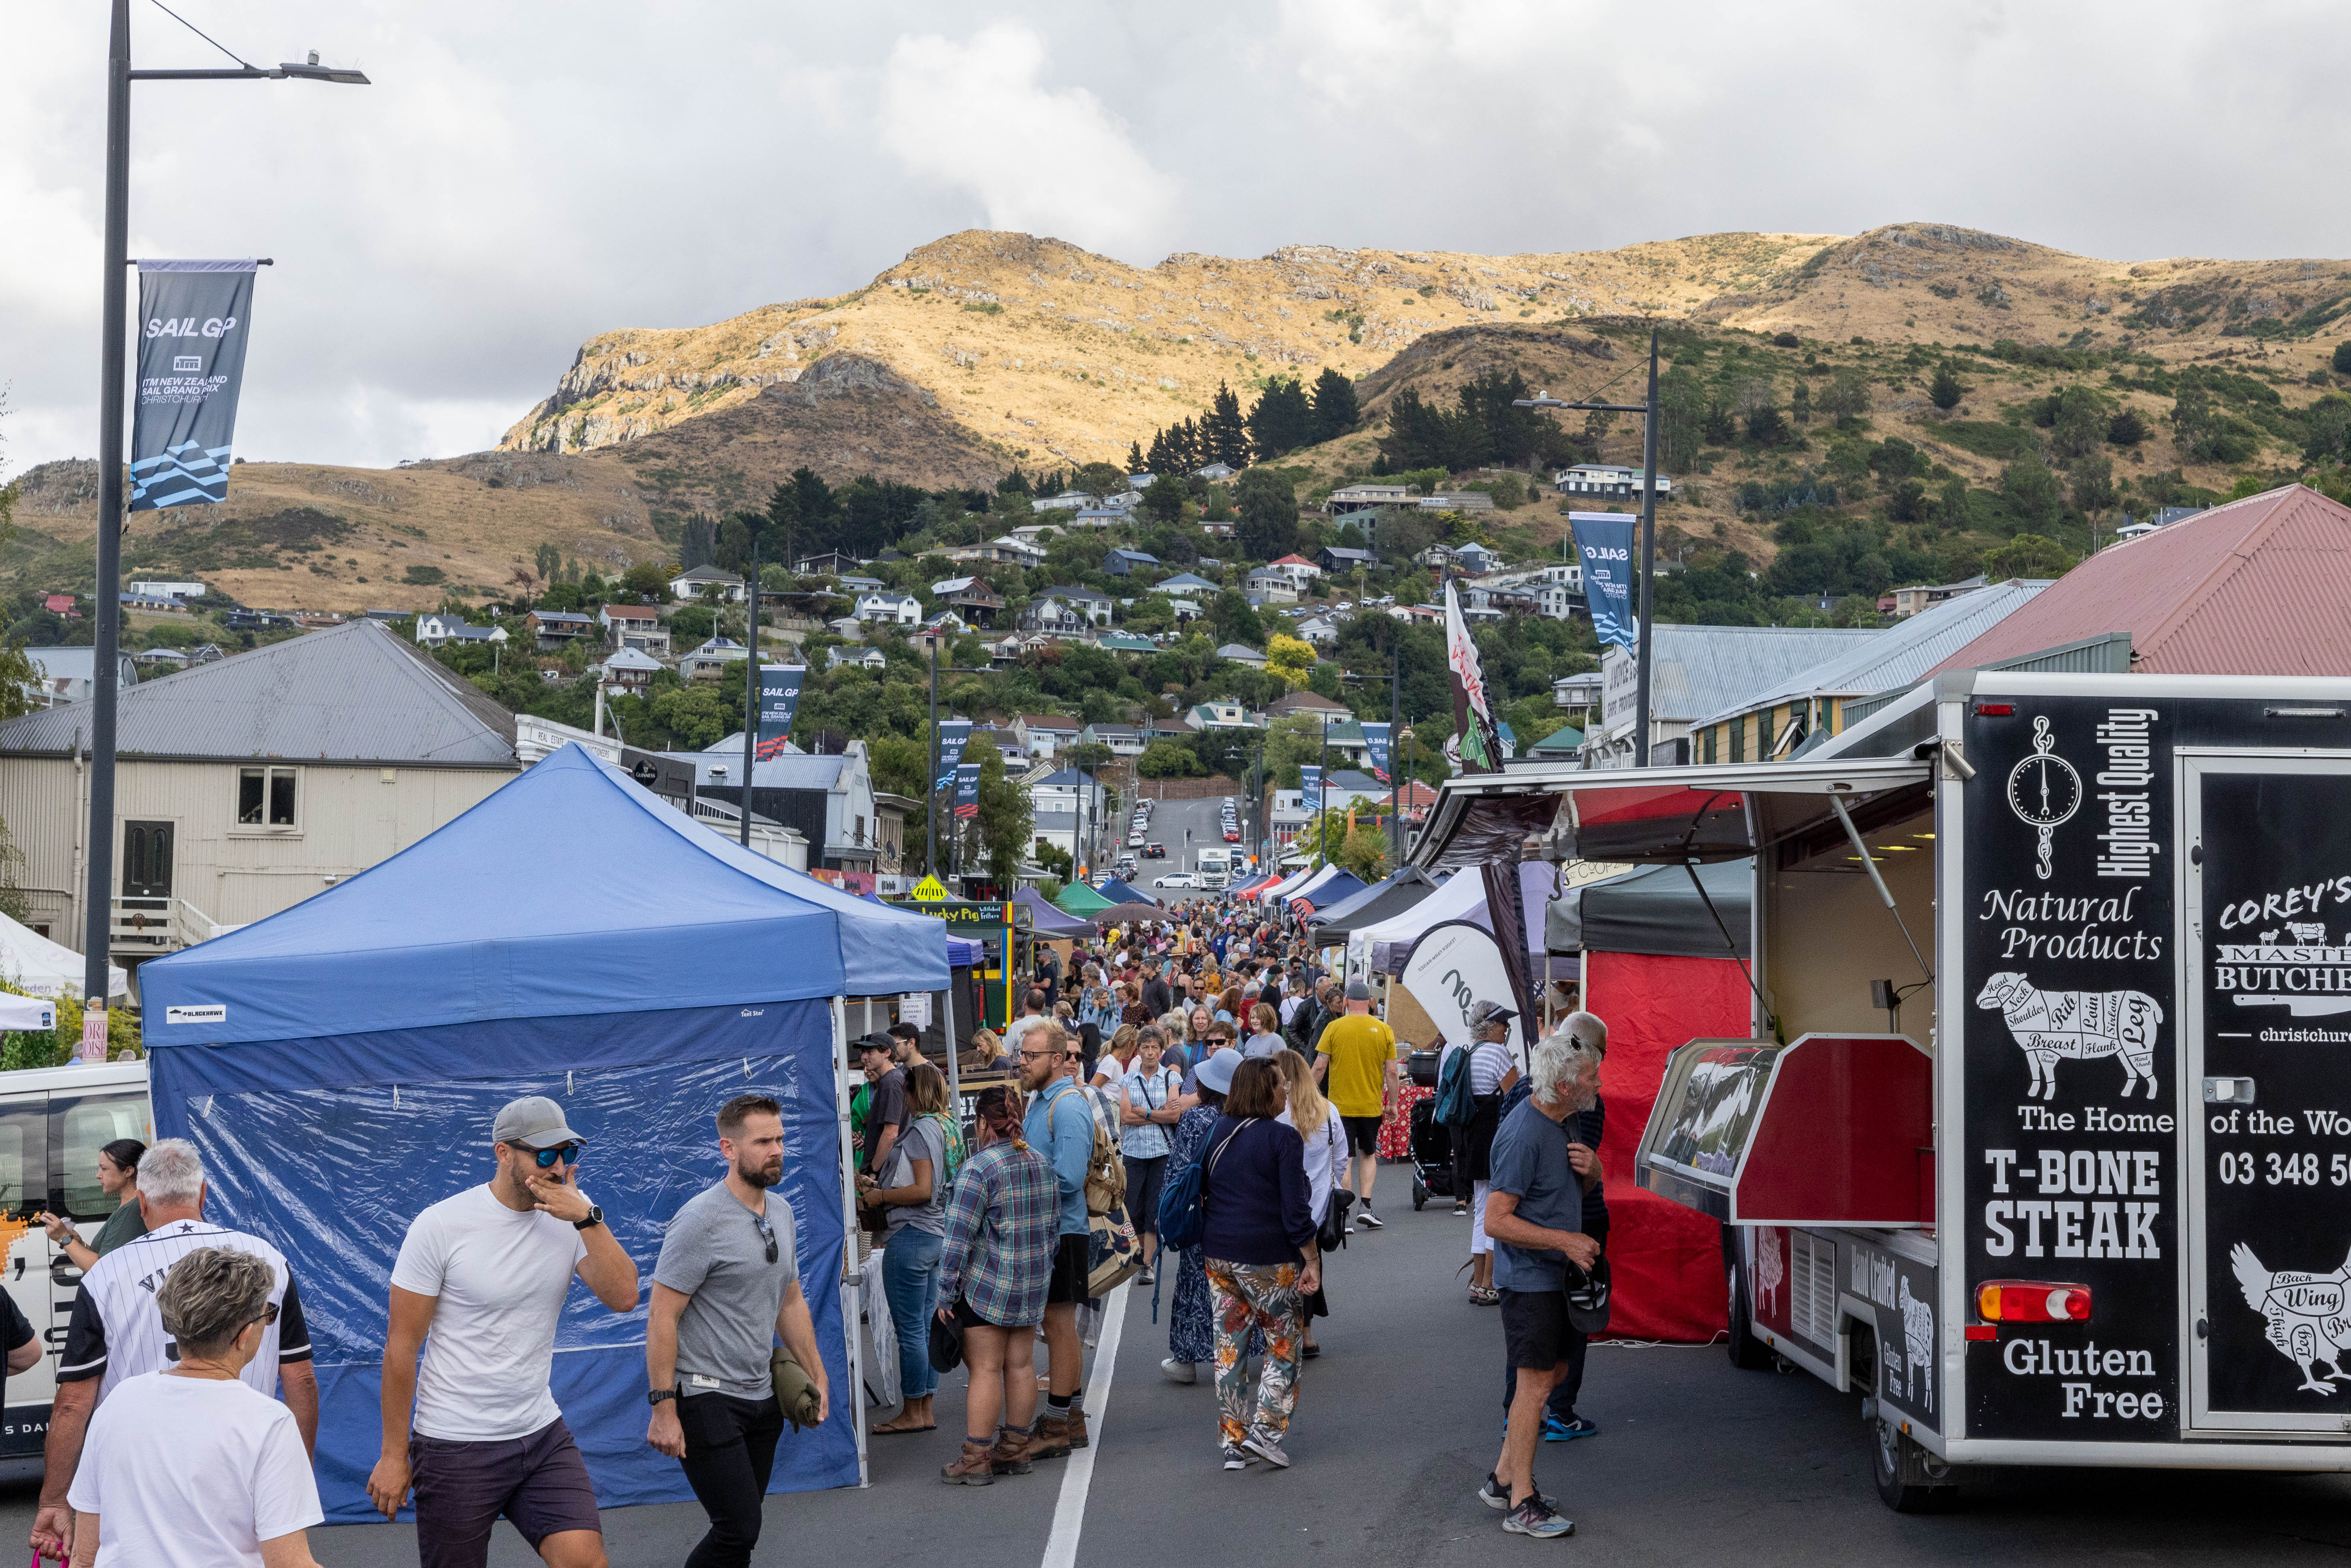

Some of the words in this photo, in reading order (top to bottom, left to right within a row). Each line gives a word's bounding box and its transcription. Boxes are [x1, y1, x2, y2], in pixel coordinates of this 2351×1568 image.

[142, 386, 162, 396] SAIL
[163, 386, 200, 395] GRAND
[143, 377, 158, 387] ITM
[159, 377, 183, 387] NEW
[141, 393, 208, 405] CHRISTCHURCH
[538, 732, 547, 742] REAL
[551, 735, 564, 747] ESTATE
[2097, 709, 2158, 785] Quality
[2097, 792, 2159, 877] Highest
[922, 907, 959, 922] Lucky
[961, 908, 979, 922] Pig
[1980, 887, 2142, 922] Natural
[2220, 876, 2351, 930] COREY'S
[2001, 923, 2162, 960] Products
[2231, 948, 2351, 962] MASTE
[1986, 974, 2008, 995] Head
[2215, 967, 2351, 991] BUTCHE
[741, 1009, 752, 1017] Tent
[1981, 999, 1998, 1008] Tongue
[2009, 986, 2030, 1012] Neck
[2051, 994, 2077, 1030] Rib
[2083, 996, 2098, 1031] Loin
[2008, 1005, 2045, 1027] Shoulder
[2106, 994, 2117, 1035] Sirloin
[2122, 995, 2151, 1049] Leg
[2027, 1033, 2076, 1050] Breast
[2085, 1040, 2117, 1054] Flank
[2259, 1028, 2351, 1042] christchurc
[2133, 1055, 2148, 1063] Hind
[2018, 1106, 2075, 1131] The
[2084, 1107, 2174, 1132] Home
[2211, 1109, 2240, 1134] of
[2247, 1110, 2294, 1134] the
[2303, 1110, 2351, 1136] Wo
[1985, 1149, 2159, 1195] T-BONE
[2220, 1152, 2255, 1185] 03
[2266, 1153, 2319, 1185] 348
[2331, 1154, 2351, 1186] 5
[1985, 1200, 2160, 1259] STEAK
[1851, 1244, 1869, 1298] Hand
[1870, 1251, 1896, 1311] Crafted
[2276, 1273, 2313, 1284] Back
[2284, 1288, 2339, 1311] Wing
[2270, 1308, 2289, 1349] Thigh
[1884, 1341, 1901, 1373] Gluten
[2004, 1339, 2156, 1376] Gluten
[2295, 1329, 2312, 1359] Leg
[1889, 1369, 1901, 1398] Free
[2061, 1383, 2163, 1419] Free
